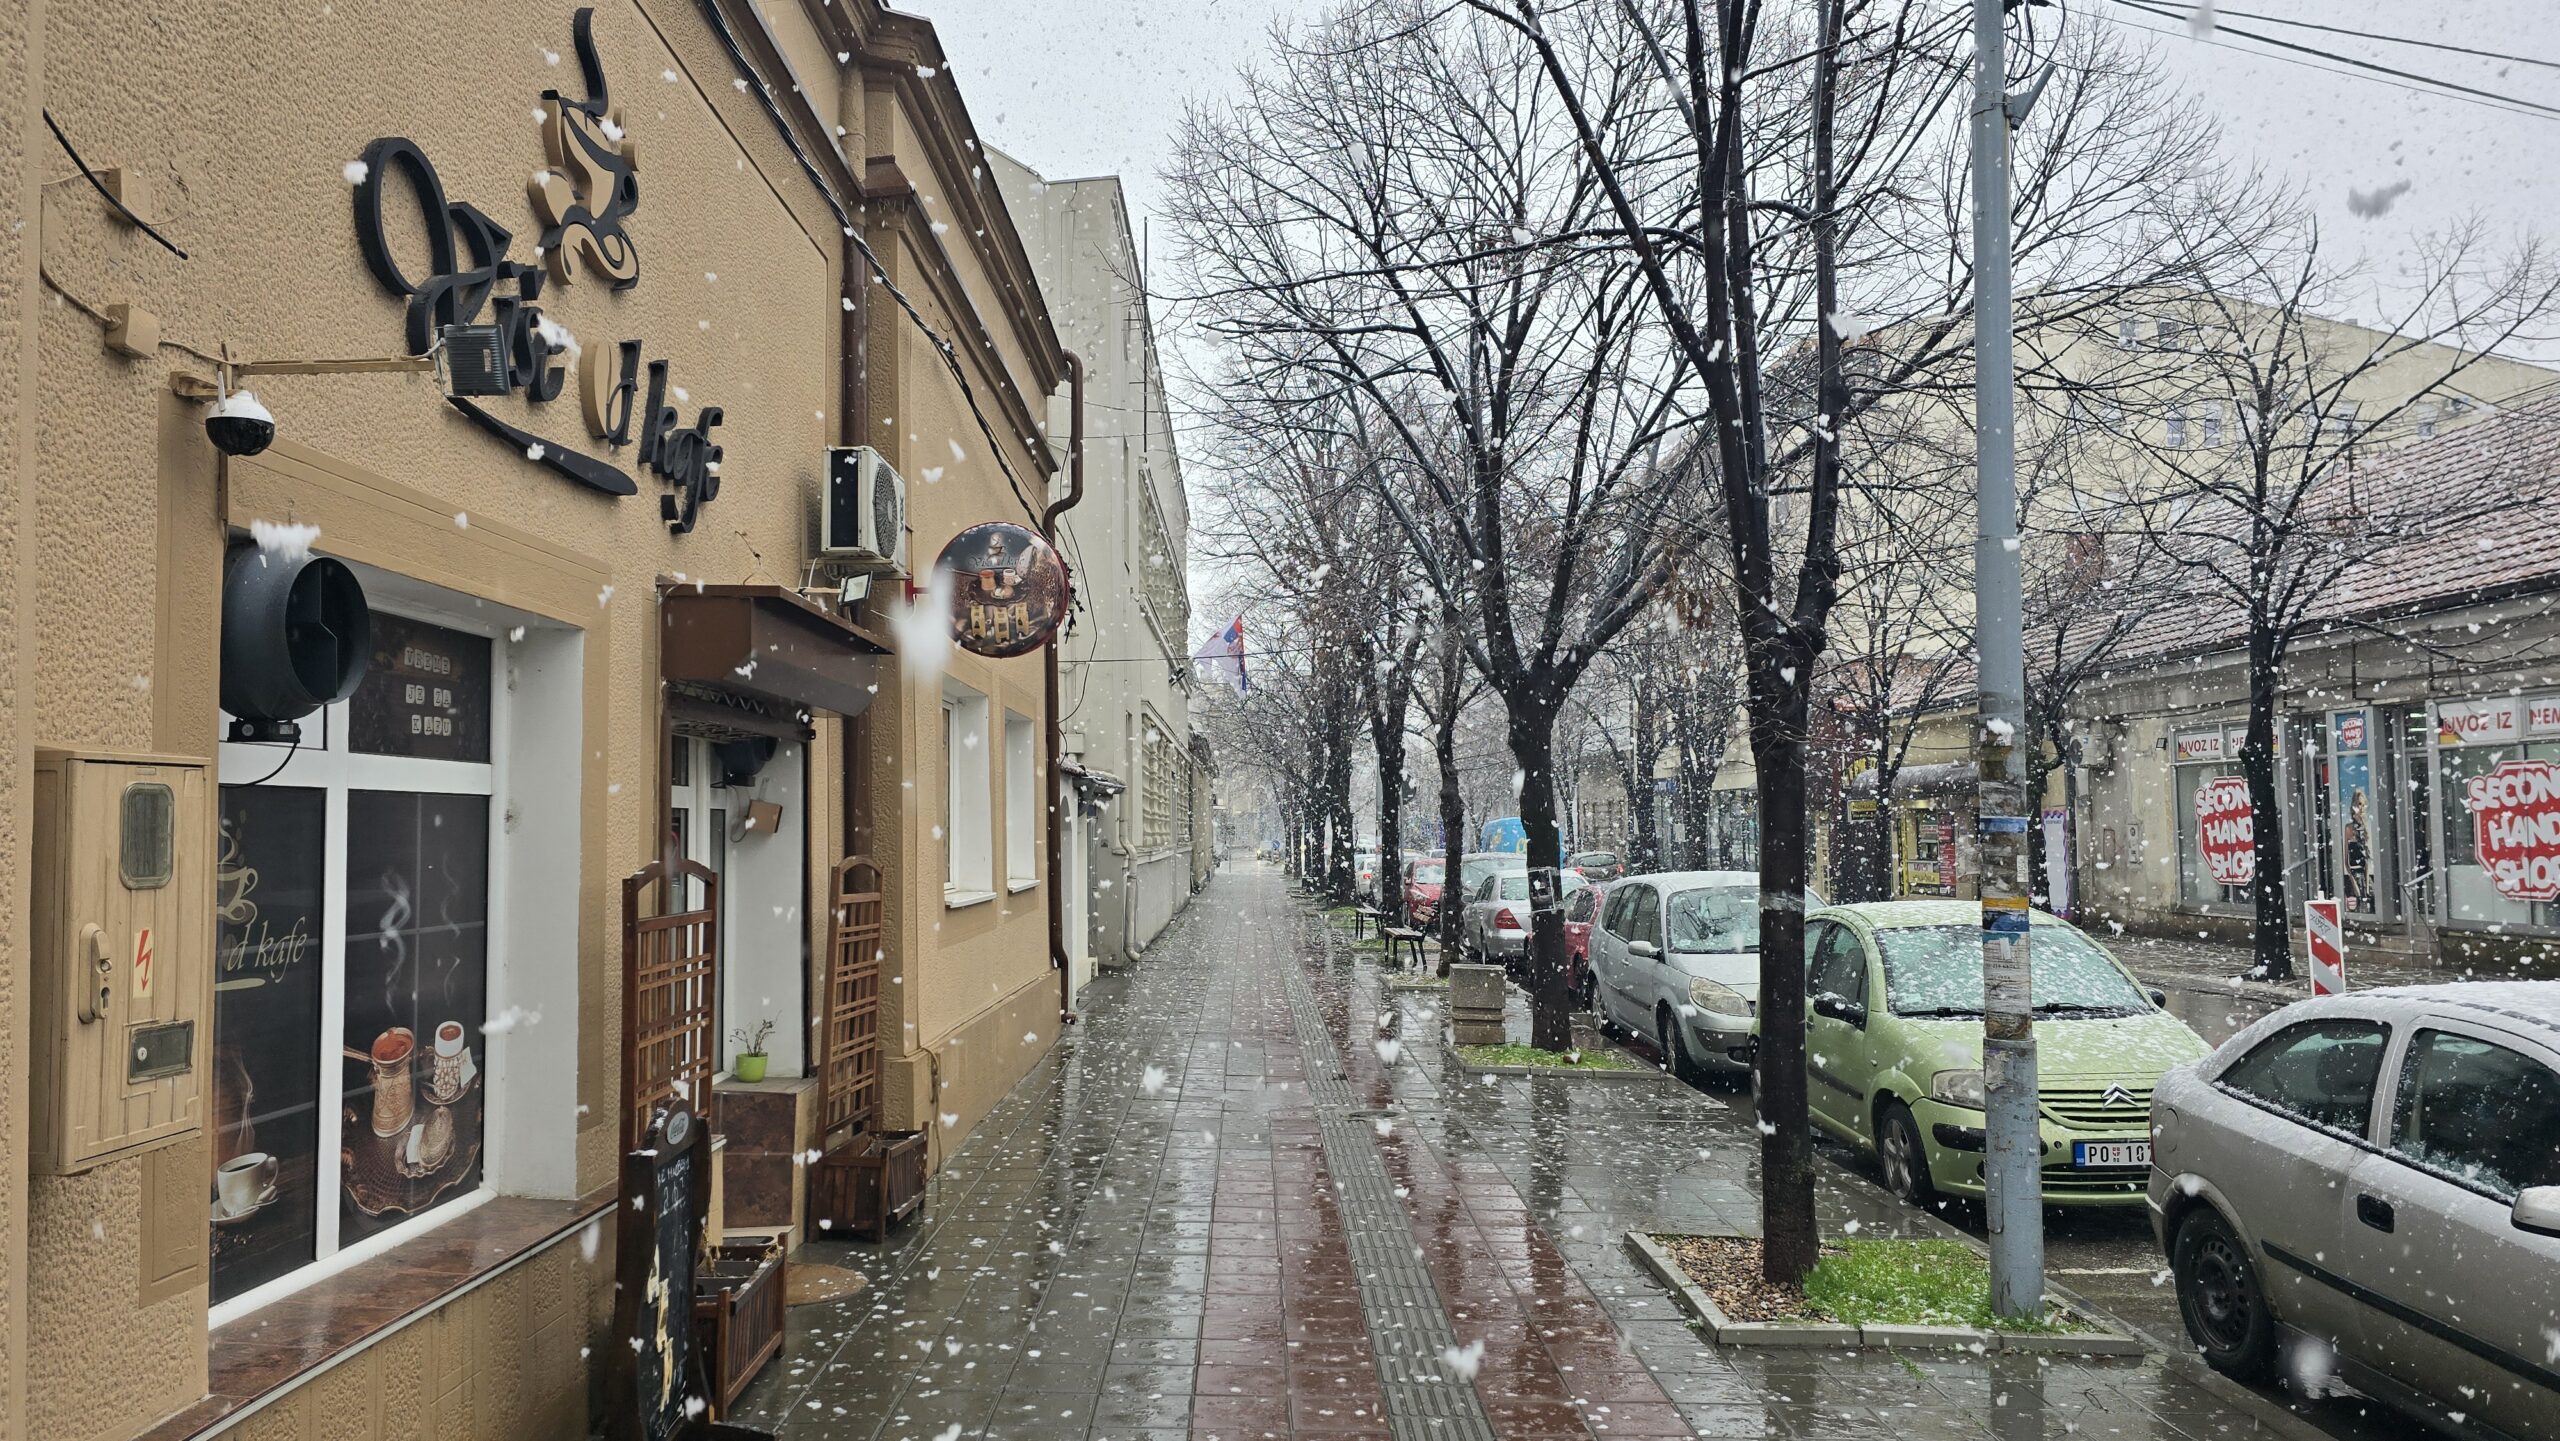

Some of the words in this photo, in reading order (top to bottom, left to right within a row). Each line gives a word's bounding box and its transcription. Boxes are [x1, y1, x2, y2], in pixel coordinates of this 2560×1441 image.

[638, 359, 723, 533] kafe
[405, 647, 450, 674] VREME
[406, 684, 424, 704] JE
[434, 688, 451, 707] ZA
[412, 715, 451, 736] KAFU
[2443, 713, 2489, 733] UVOZ
[2496, 711, 2513, 729] IZ
[2181, 740, 2207, 753] UVOZ
[2210, 738, 2219, 751] IZ
[2195, 782, 2252, 816] SECON
[255, 916, 307, 983] kafe
[2089, 1145, 2109, 1163] PO
[2126, 1145, 2151, 1163] 10
